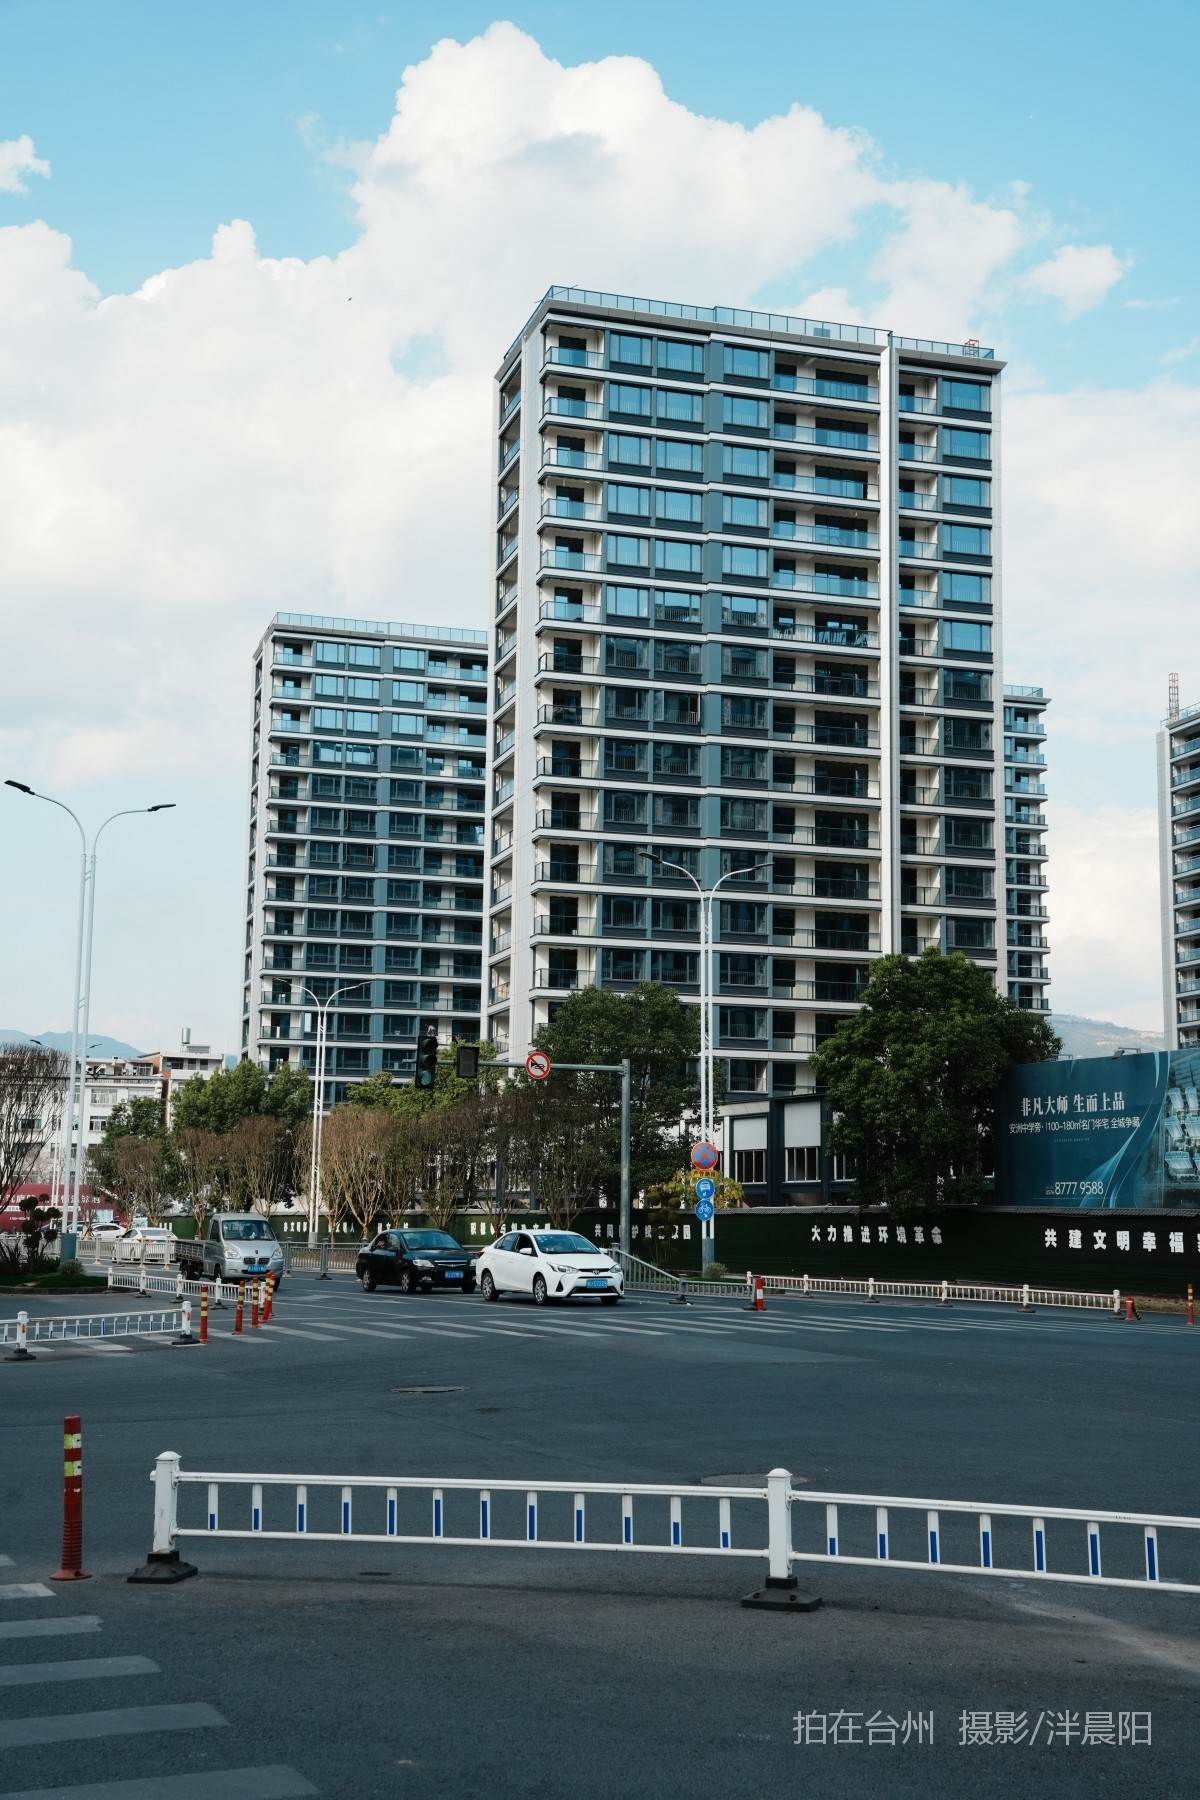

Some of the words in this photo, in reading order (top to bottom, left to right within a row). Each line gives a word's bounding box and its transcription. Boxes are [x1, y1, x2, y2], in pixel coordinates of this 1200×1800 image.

[1021, 1095, 1068, 1117] 非凡大师
[1073, 1091, 1125, 1113] 生而上品
[1054, 1181, 1077, 1195] 8777
[1079, 1181, 1104, 1195] 9588
[811, 1224, 942, 1245] 大力推进环境革命
[1044, 1228, 1200, 1253] 共建文明幸福
